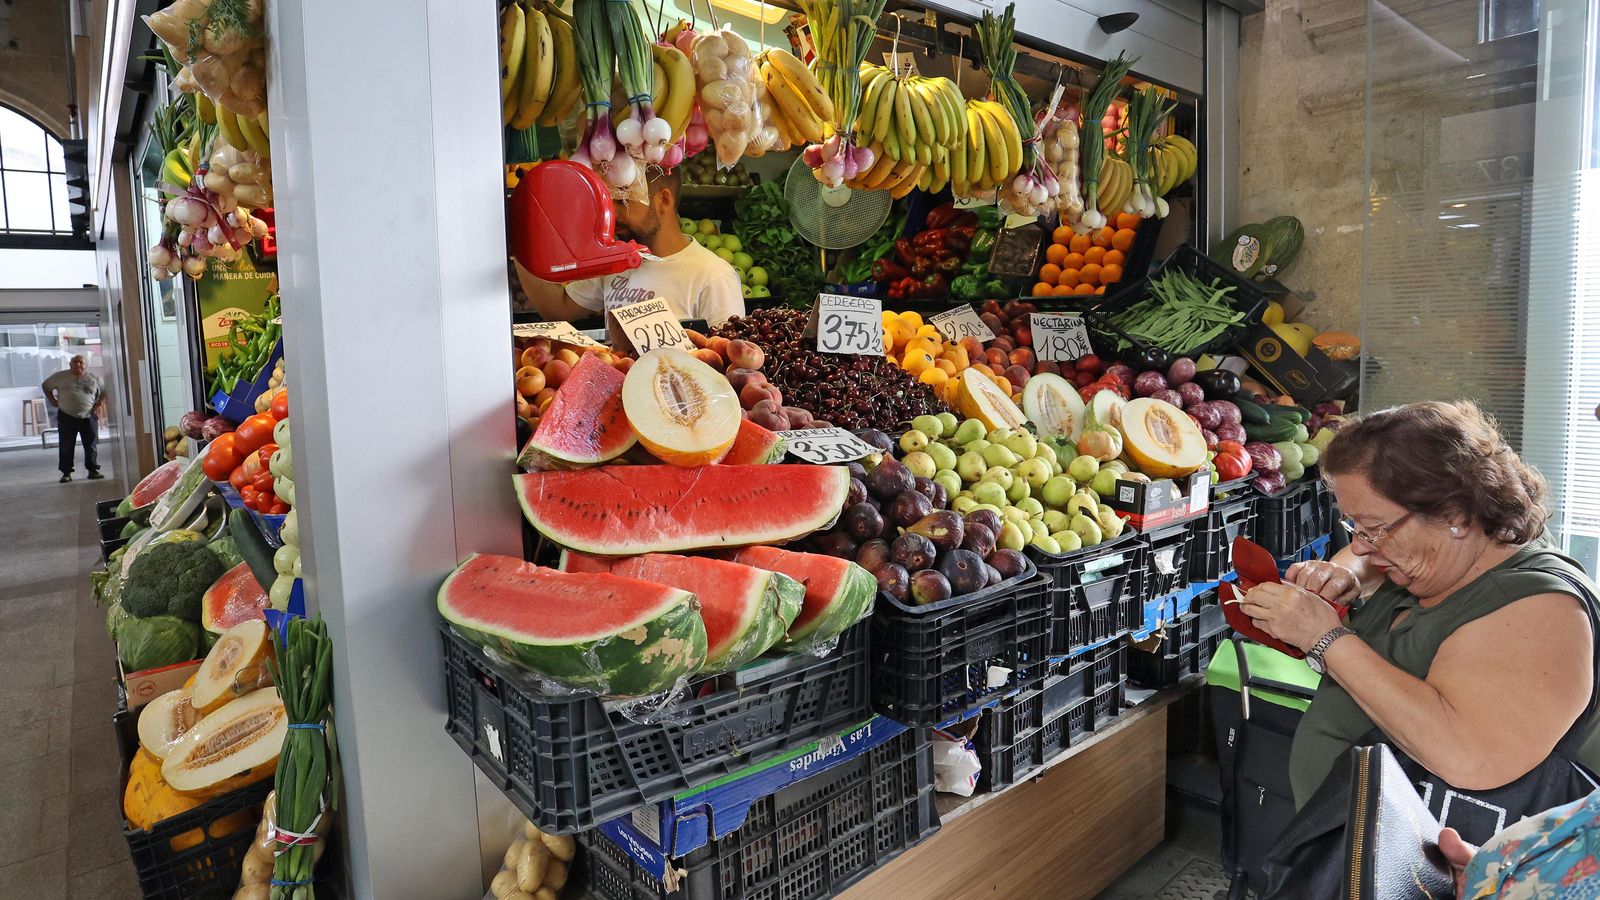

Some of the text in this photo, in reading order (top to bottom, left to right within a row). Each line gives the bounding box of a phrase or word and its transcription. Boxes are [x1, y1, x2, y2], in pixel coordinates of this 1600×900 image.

[244, 272, 254, 280] DE
[616, 300, 666, 321] PARAGUAYO
[821, 295, 876, 311] CEREZAS
[850, 722, 873, 745] Las
